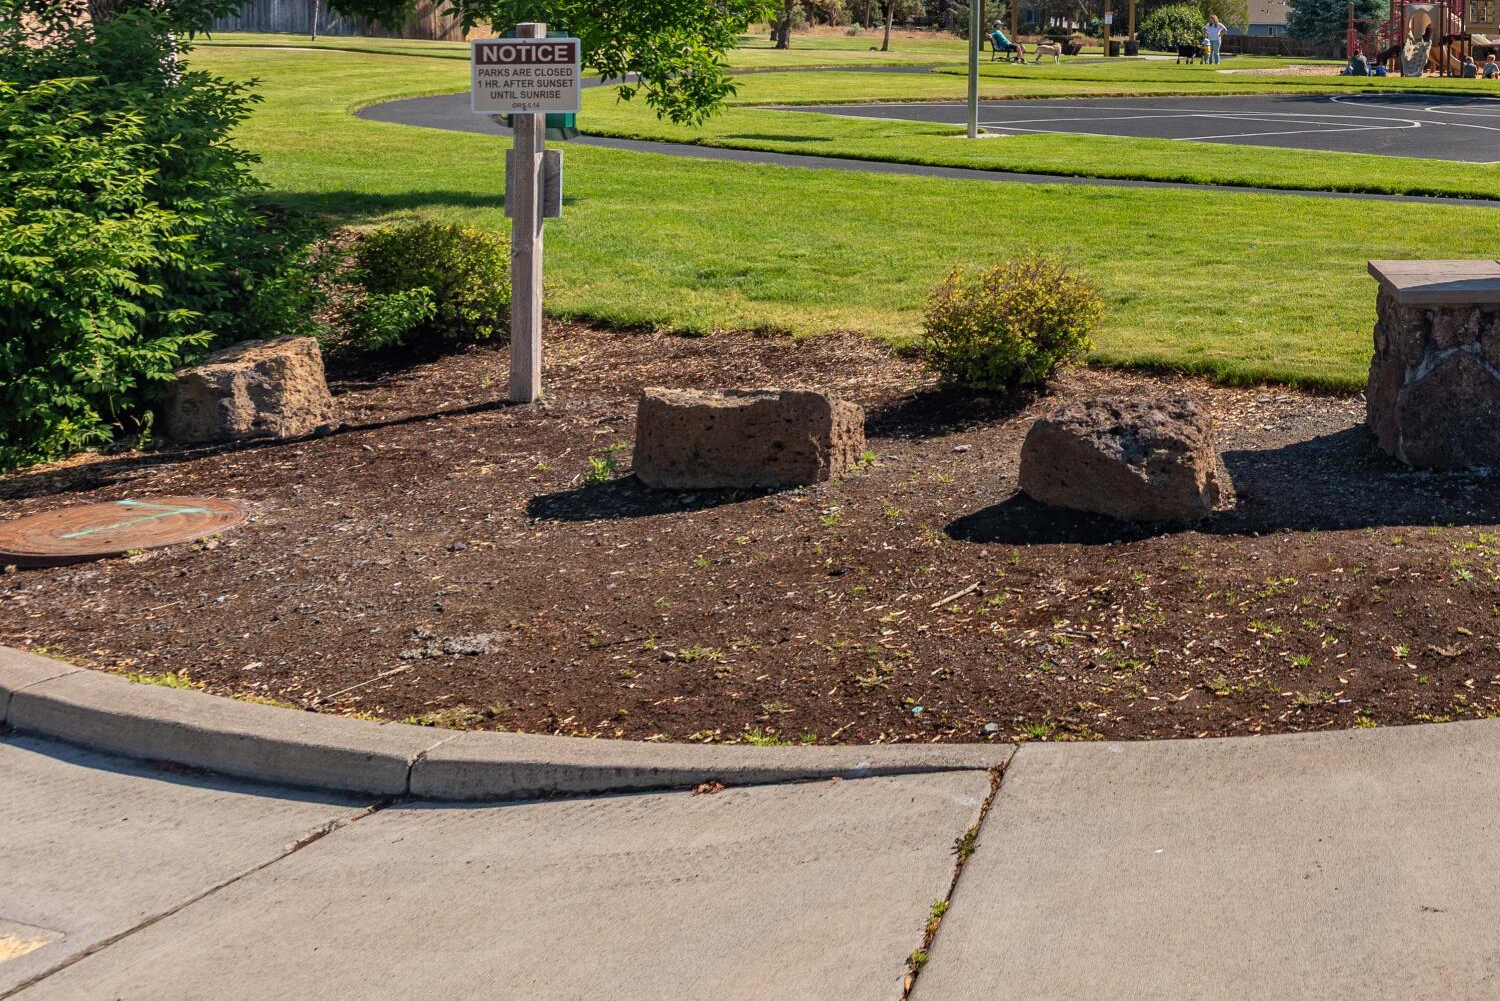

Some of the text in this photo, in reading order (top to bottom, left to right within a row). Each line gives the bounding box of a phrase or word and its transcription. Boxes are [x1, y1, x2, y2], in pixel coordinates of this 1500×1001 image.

[482, 45, 569, 62] NOTICE
[478, 68, 573, 77] PARKS ARE CLOSED
[478, 79, 574, 88] 1 HR. AFTER SUNSET
[490, 91, 561, 99] UNTIL SUNRISE
